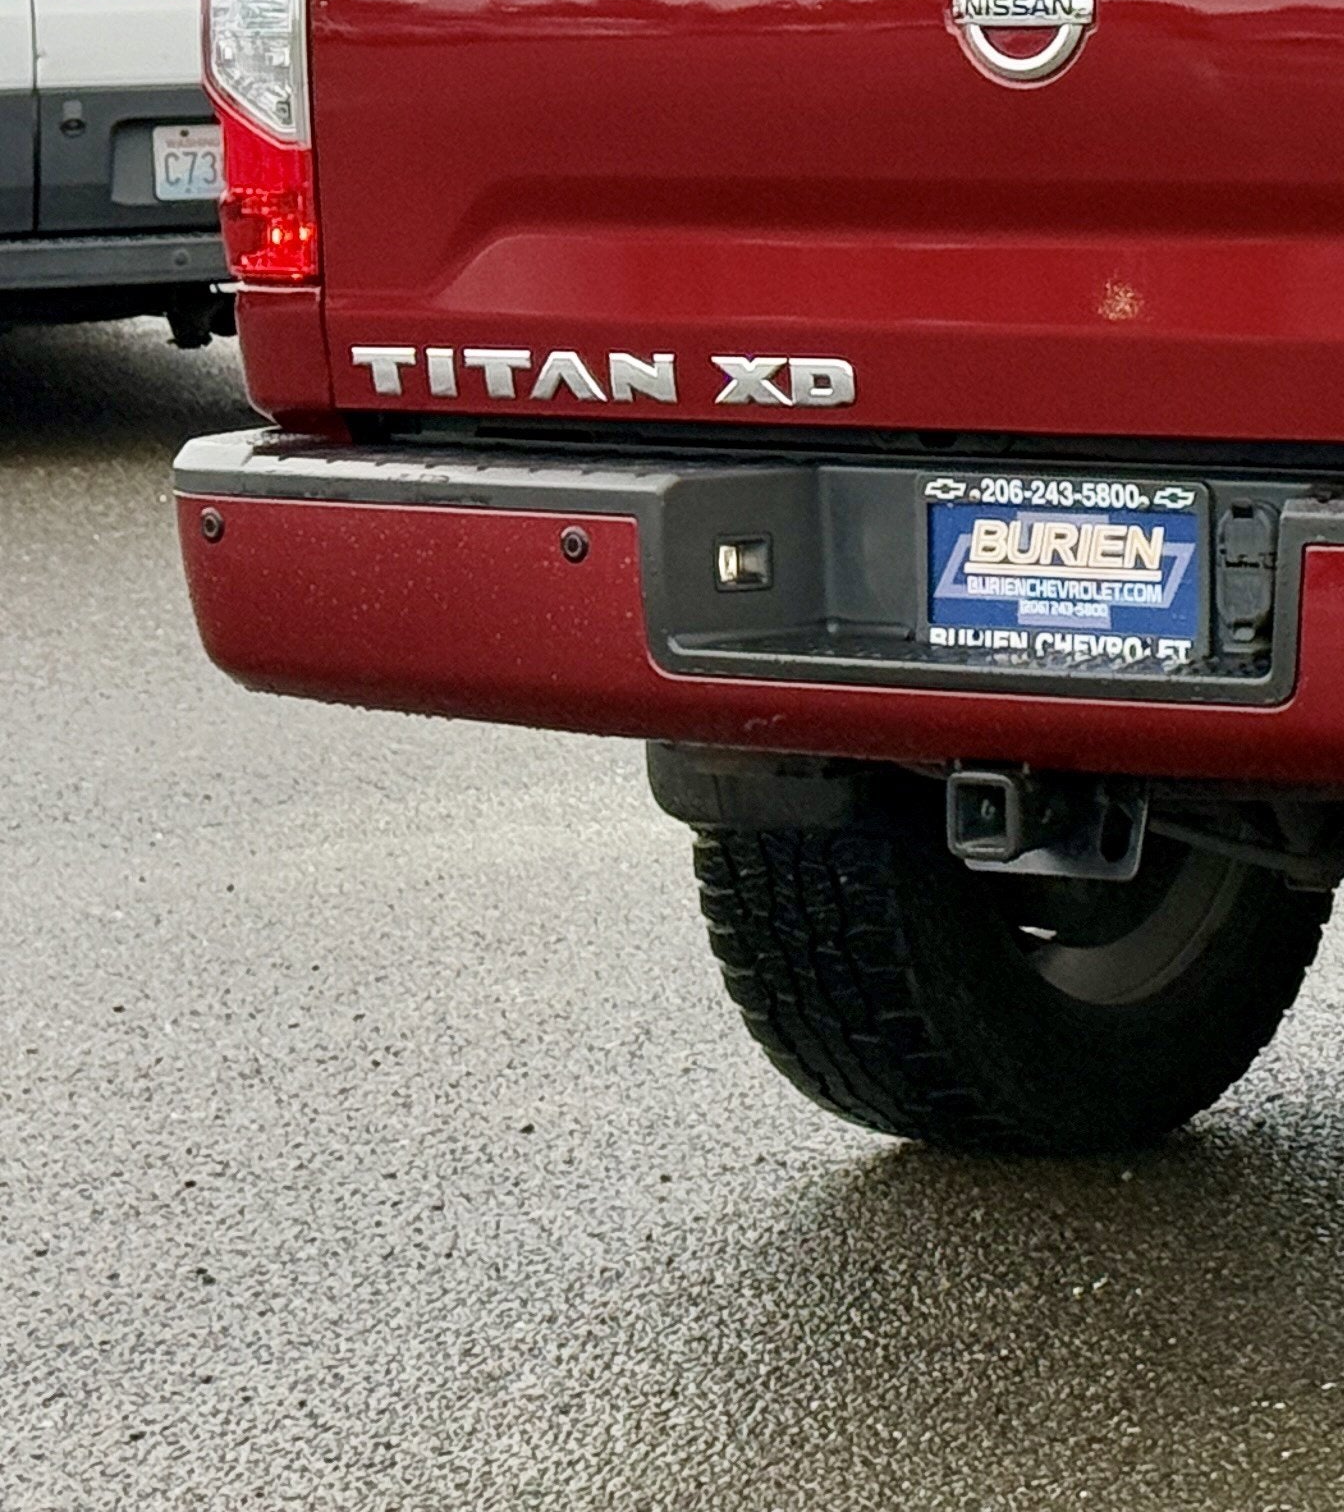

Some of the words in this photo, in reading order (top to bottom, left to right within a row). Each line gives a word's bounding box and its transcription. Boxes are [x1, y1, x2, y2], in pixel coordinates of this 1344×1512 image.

[164, 151, 218, 186] C73
[351, 346, 679, 404] TITAN
[711, 354, 857, 407] XD
[979, 477, 1141, 510] 206-243-5800
[968, 518, 1166, 571] BURIEN
[1033, 631, 1193, 665] CHEVROET
